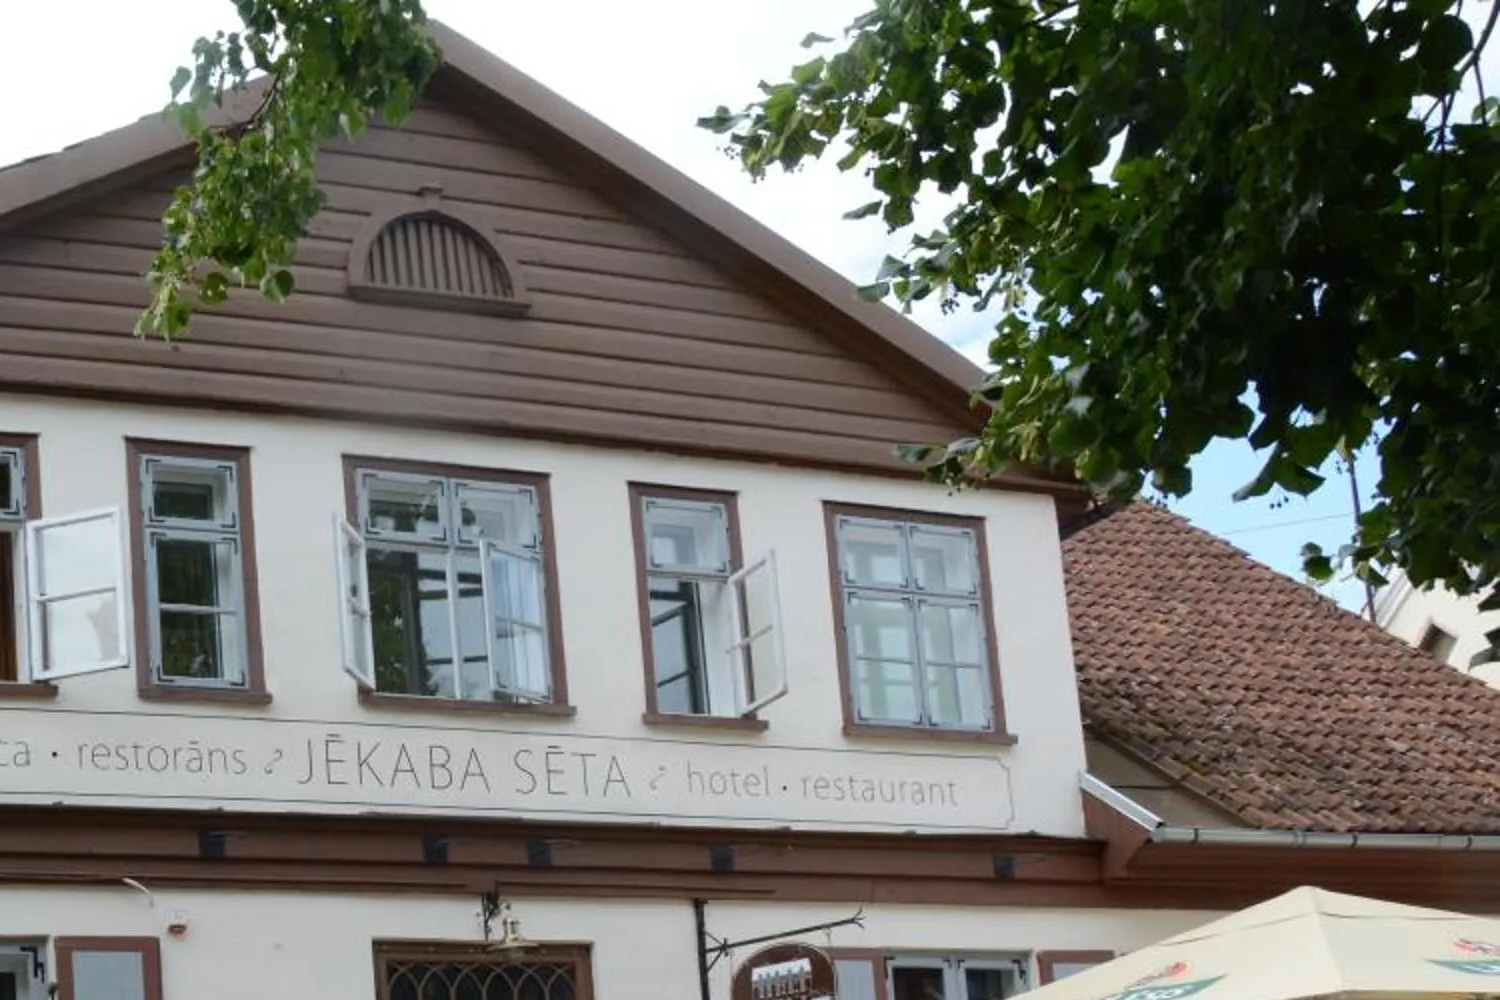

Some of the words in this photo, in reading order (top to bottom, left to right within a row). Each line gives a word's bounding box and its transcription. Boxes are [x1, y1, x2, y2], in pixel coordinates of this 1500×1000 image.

[77, 740, 248, 776] restorāns
[297, 733, 491, 794] JĒKABA
[514, 745, 632, 798] SĒTA
[686, 759, 770, 798] hotel
[801, 774, 959, 808] restaurant
